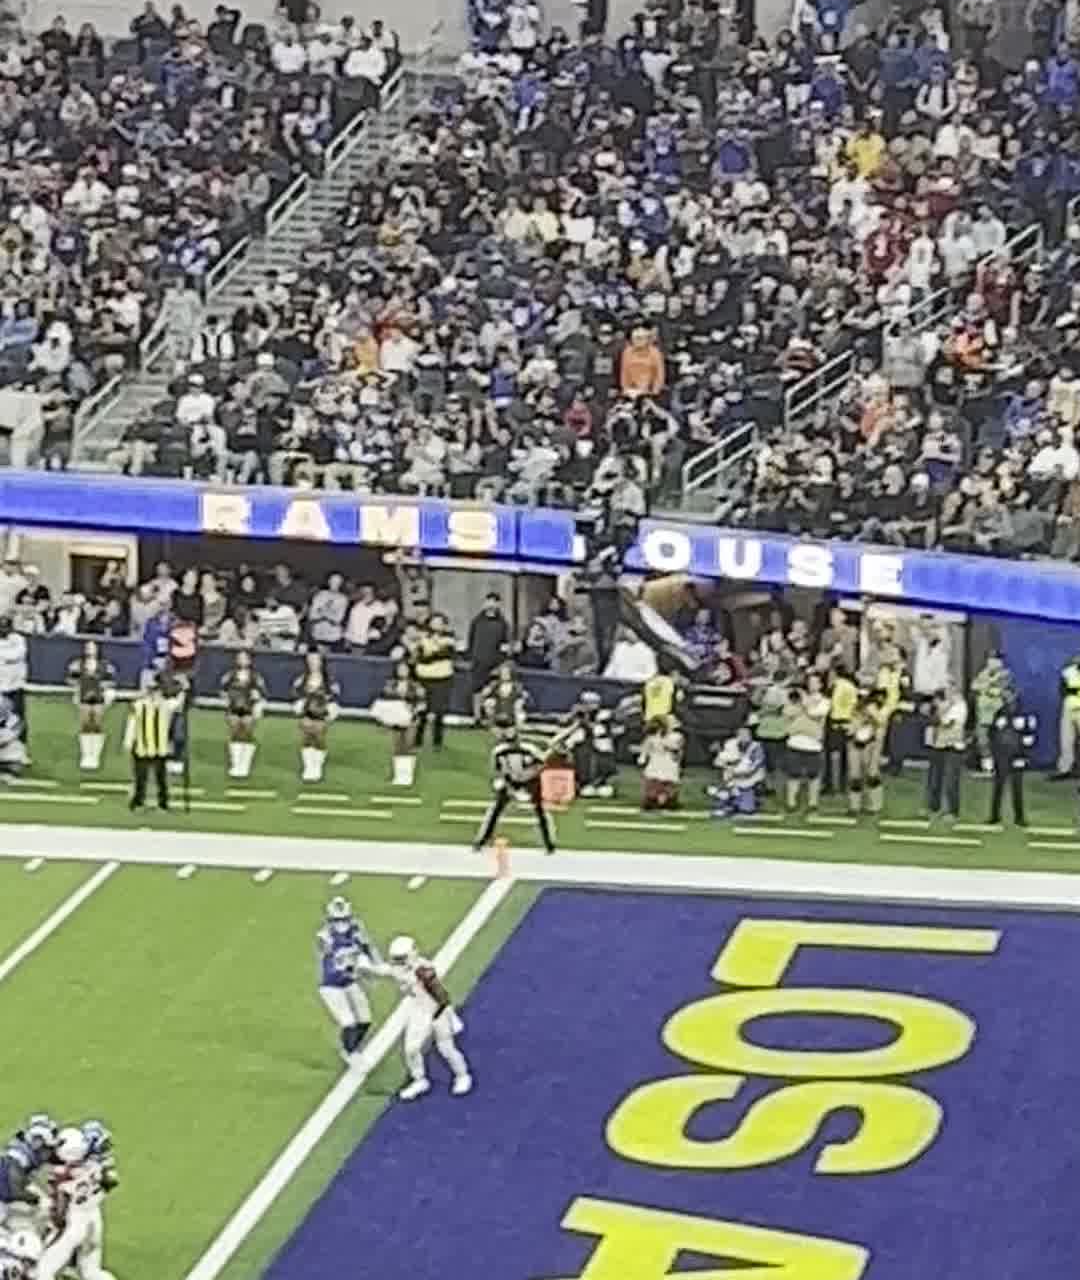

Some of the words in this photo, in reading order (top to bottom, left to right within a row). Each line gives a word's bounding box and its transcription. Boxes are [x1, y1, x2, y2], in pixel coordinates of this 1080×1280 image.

[201, 493, 498, 552] RAMS
[572, 528, 904, 595] OUSE
[605, 918, 1002, 1176] LOS
